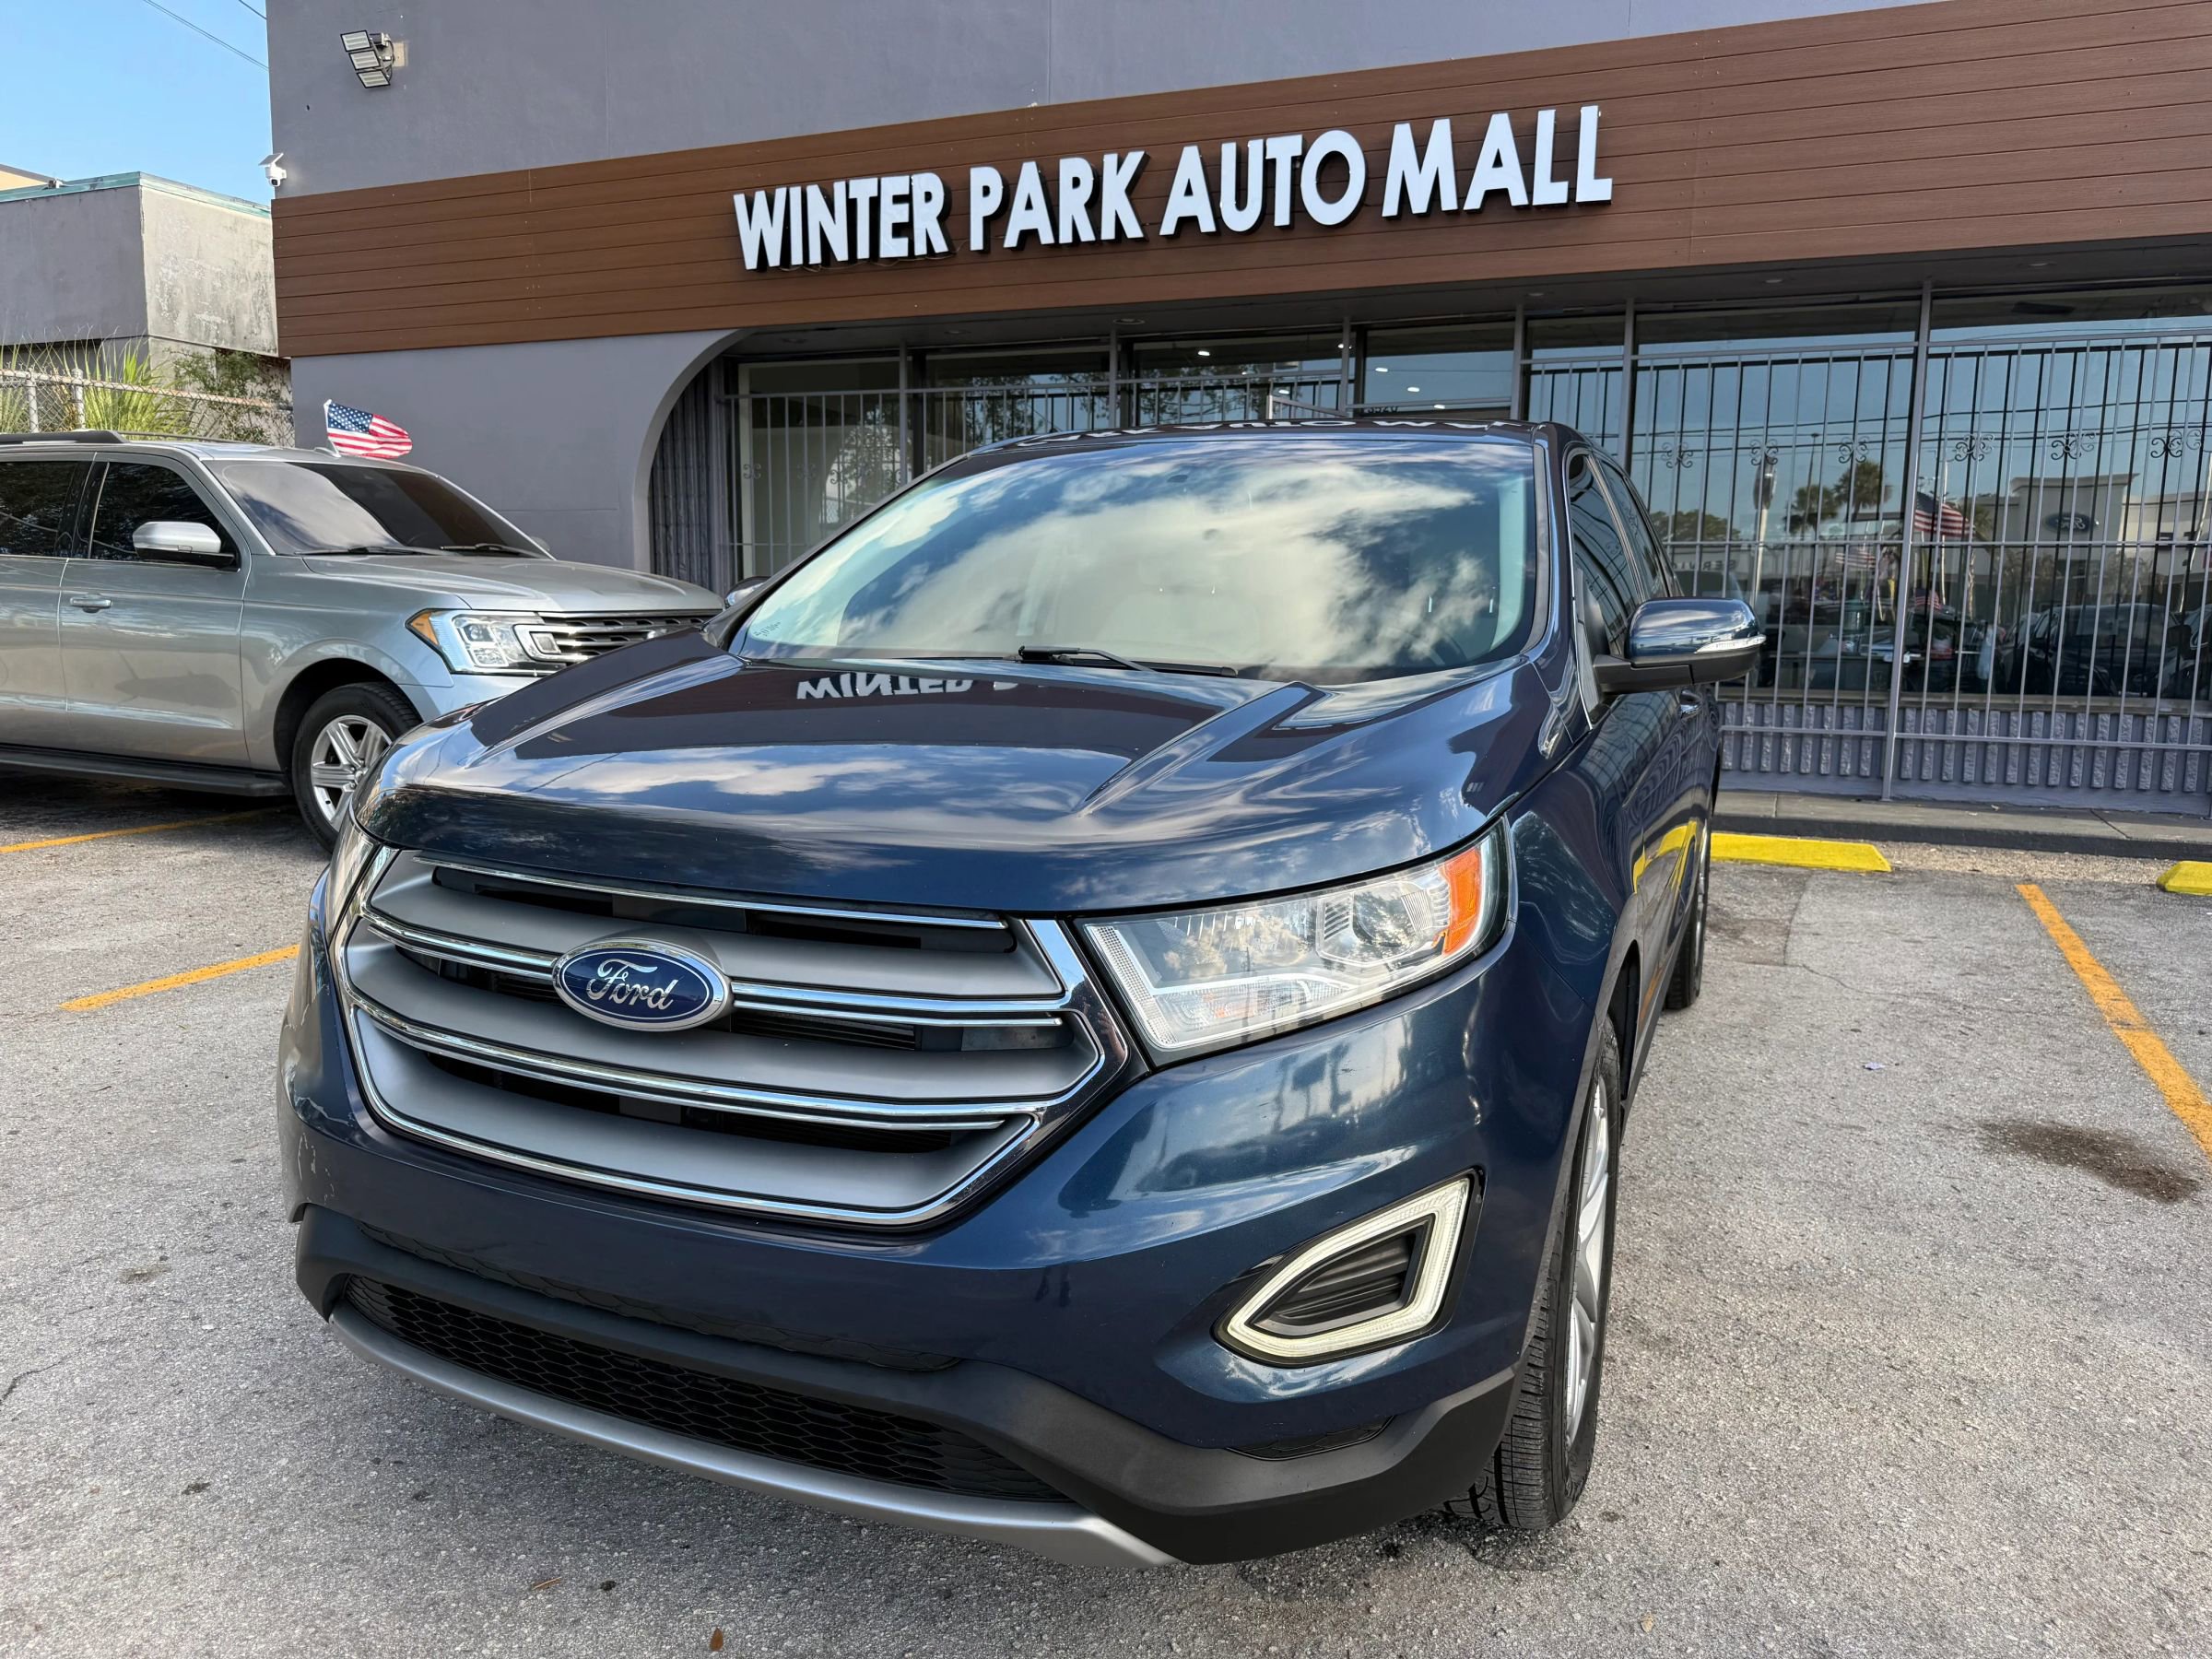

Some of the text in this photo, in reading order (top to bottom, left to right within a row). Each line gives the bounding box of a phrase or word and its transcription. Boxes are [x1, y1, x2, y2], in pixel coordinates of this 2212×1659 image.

[733, 104, 1614, 270] WINTER PARK AUTO MALL
[585, 958, 679, 1011] Ford
